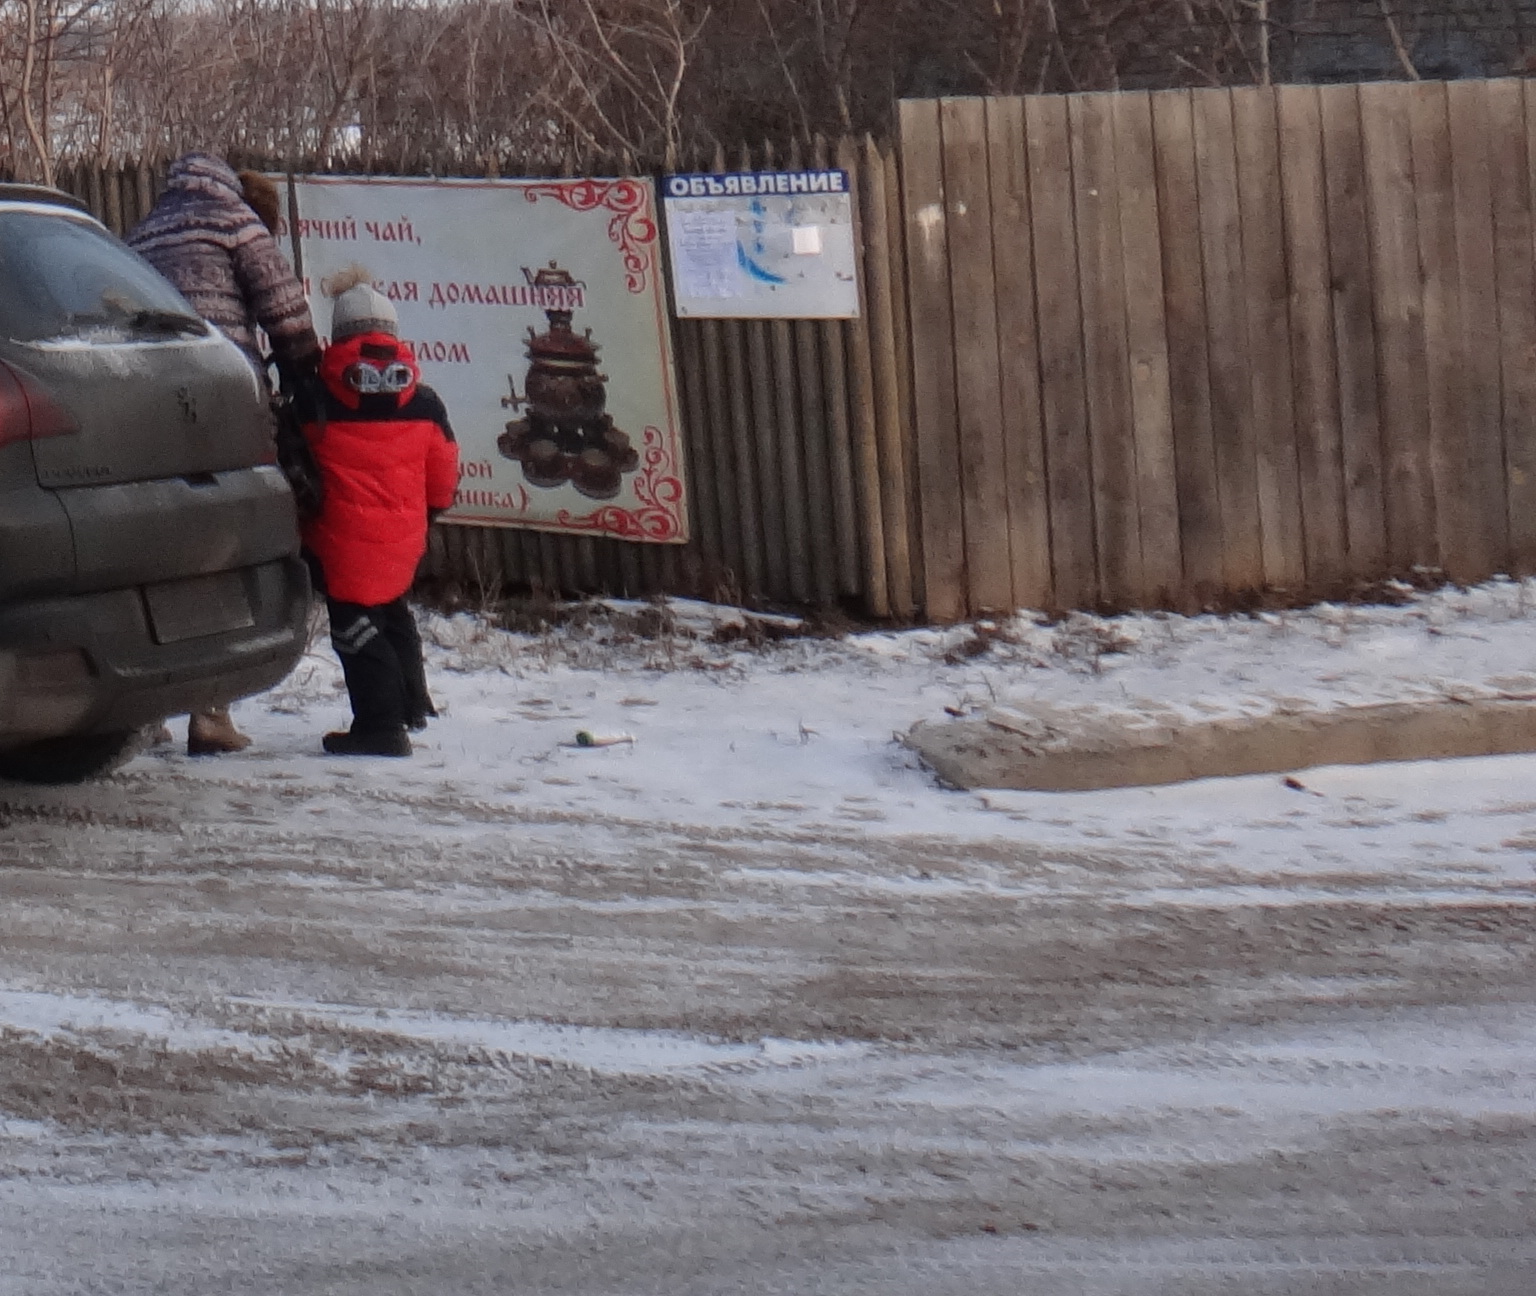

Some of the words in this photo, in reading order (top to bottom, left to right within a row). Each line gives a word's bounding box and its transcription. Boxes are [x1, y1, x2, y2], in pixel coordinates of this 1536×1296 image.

[669, 171, 843, 197] ОБЪЯВЛЕНИЕ
[364, 214, 422, 246] чай,
[429, 281, 585, 309] домашняя
